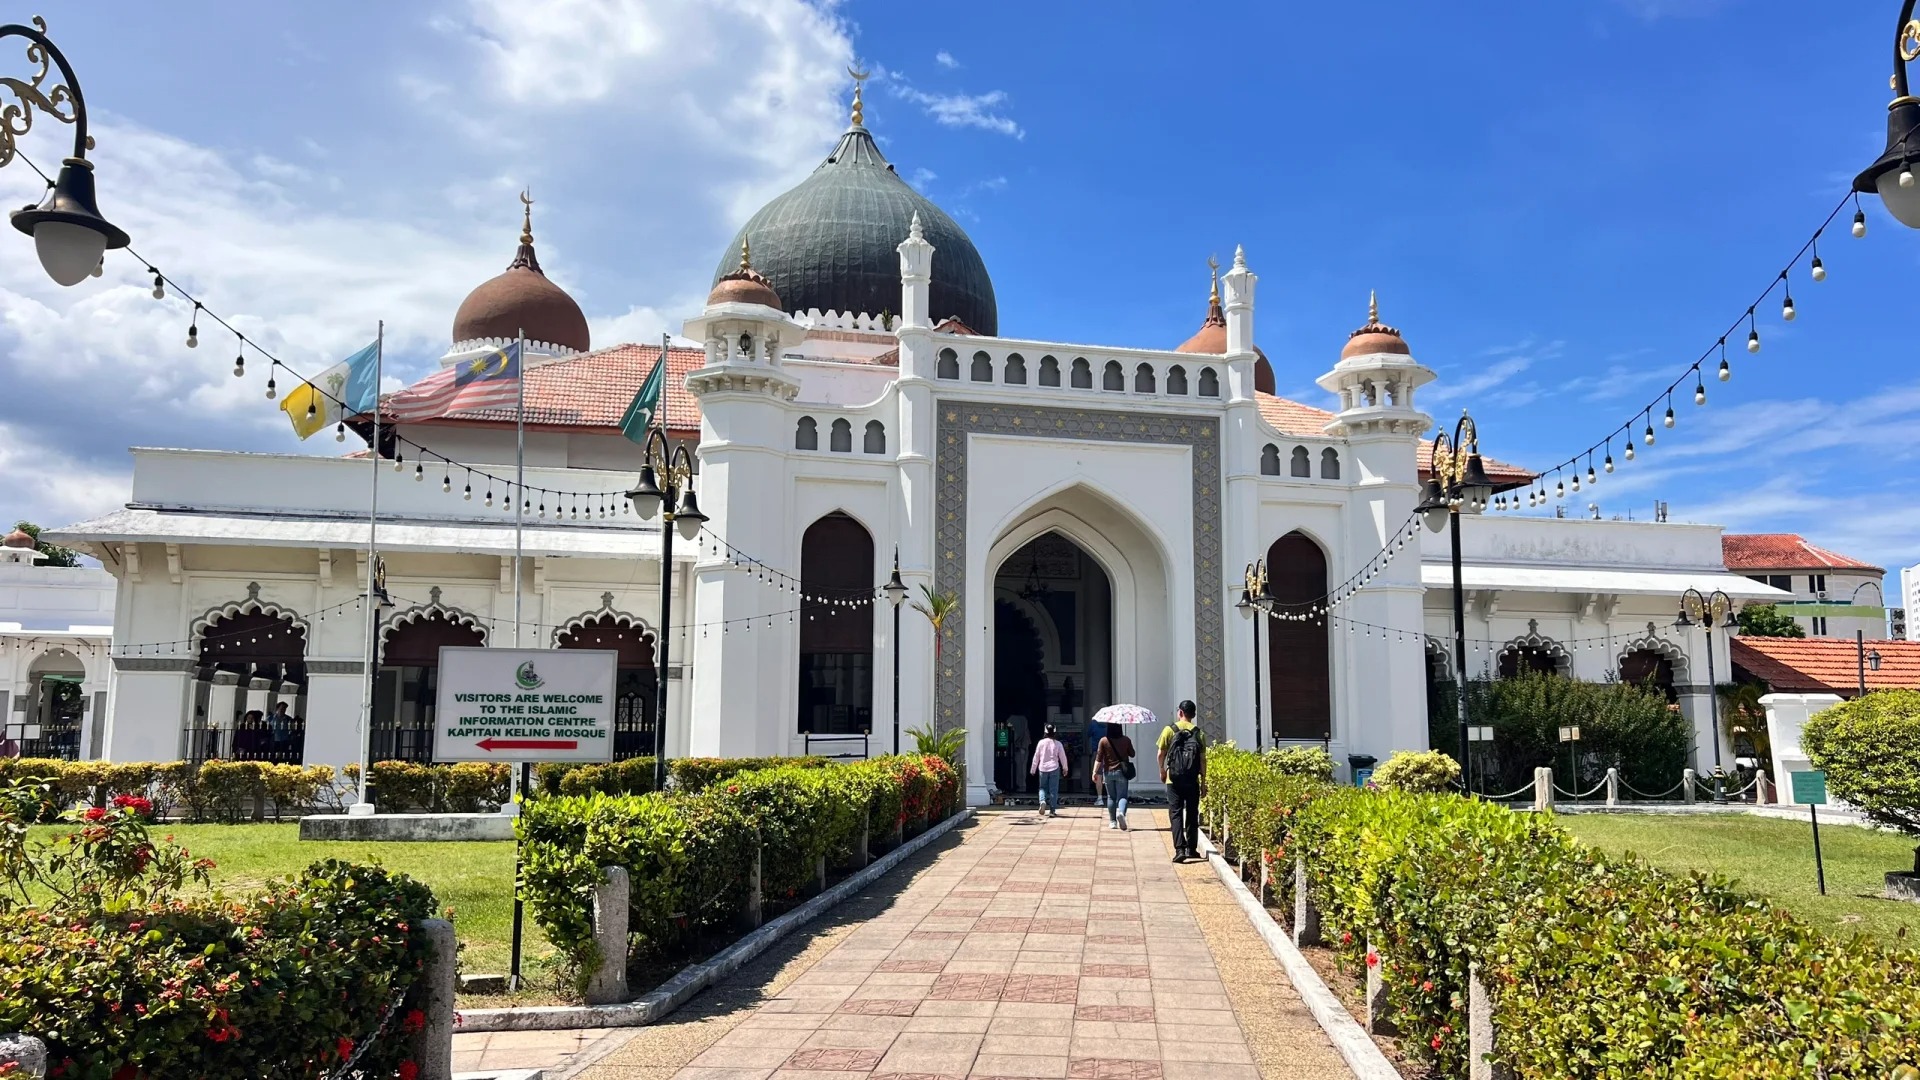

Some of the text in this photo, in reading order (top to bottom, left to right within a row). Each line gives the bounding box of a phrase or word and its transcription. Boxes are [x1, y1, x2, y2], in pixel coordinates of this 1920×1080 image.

[455, 694, 602, 704] VISITORS ARE WELCOME
[480, 705, 577, 715] TO THE ISLAMIC
[460, 717, 595, 726] INFORMATION CENTRE
[448, 728, 605, 738] KAPITAN KELING MOSQUE
